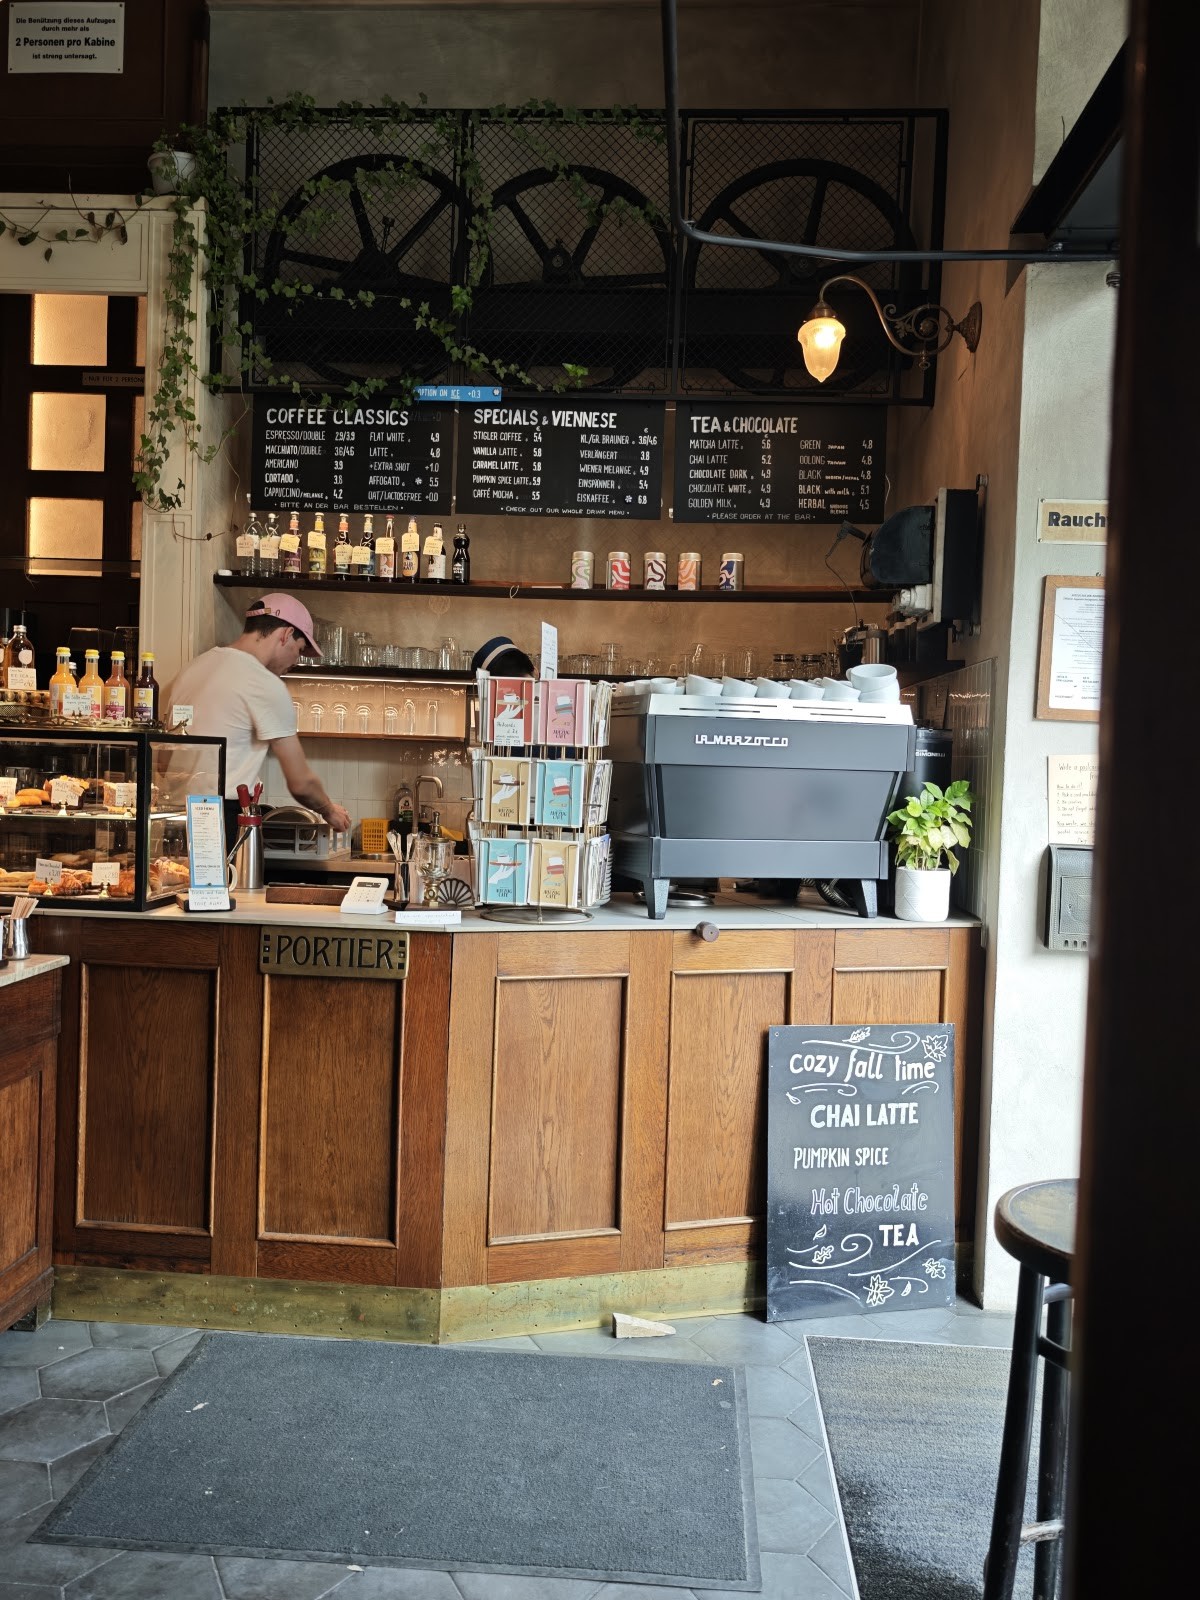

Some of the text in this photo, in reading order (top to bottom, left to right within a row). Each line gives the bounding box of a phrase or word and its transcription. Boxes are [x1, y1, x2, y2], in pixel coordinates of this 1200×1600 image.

[16, 38, 116, 48] 2 Personen pro Kabine
[451, 390, 460, 399] ICE
[468, 390, 480, 399] +0.3
[266, 408, 327, 425] COFFEE
[333, 408, 409, 426] CLASSICS
[474, 408, 618, 428] SPECIALS & VIENNESE
[690, 416, 798, 434] TEA & CHOCOLATE
[265, 430, 326, 441] ESPRESSO/DOUBLE
[370, 432, 440, 442] FLAT WHITE 4.9
[500, 432, 522, 442] COFFEE
[533, 432, 542, 442] 5.4
[602, 434, 630, 445] BRAUNER
[689, 439, 771, 450] MATCHA LATTE 5.6
[800, 440, 822, 450] GREEN
[862, 440, 873, 450] 4.8
[370, 448, 389, 457] LATTE
[473, 446, 497, 456] VANILLA
[498, 448, 518, 456] LATTE
[580, 449, 650, 461] VERLÄNGERT 3.8
[264, 458, 344, 470] AMERICANO 3.9
[472, 460, 499, 470] CARAMEL
[500, 461, 519, 470] LATTE
[689, 454, 772, 465] CHAI LATTE 5.2
[800, 454, 826, 465] OOLONG
[862, 454, 872, 466] 4.8
[394, 462, 410, 472] SHOT
[579, 464, 649, 476] WIENER MELANGE 4.9
[264, 472, 294, 484] CORTADO
[472, 474, 541, 486] PUMPKIN SPICE LATTE 5.9
[688, 469, 771, 479] CHOCOLATE DARK 4.9
[798, 469, 872, 480] BLACK 4.8
[368, 476, 440, 487] AFFOGATO 5.5
[578, 478, 648, 490] EINSPÄNNER 5.4
[332, 488, 344, 500] 4.2
[472, 488, 541, 500] CAFFÉ MOCHA 5.5
[688, 484, 771, 494] CHOCOLATE WHITE 4.9
[798, 484, 821, 494] BLACK
[860, 484, 870, 495] 5.1
[576, 492, 648, 505] EISKAFFEE 6.8
[688, 498, 770, 508] GOLDEN MILK 4.9
[798, 498, 870, 510] HERBAL 4.5
[1048, 512, 1109, 528] Rauch
[695, 734, 788, 747] LA MARZOCCO
[276, 934, 394, 970] PORTIER
[844, 1048, 884, 1082] fall
[810, 1102, 919, 1129] CHAI LATTE
[793, 1146, 888, 1170] PUMPKIN SPICE
[810, 1182, 928, 1216] Hot Chocolate
[878, 1222, 920, 1247] TEA
